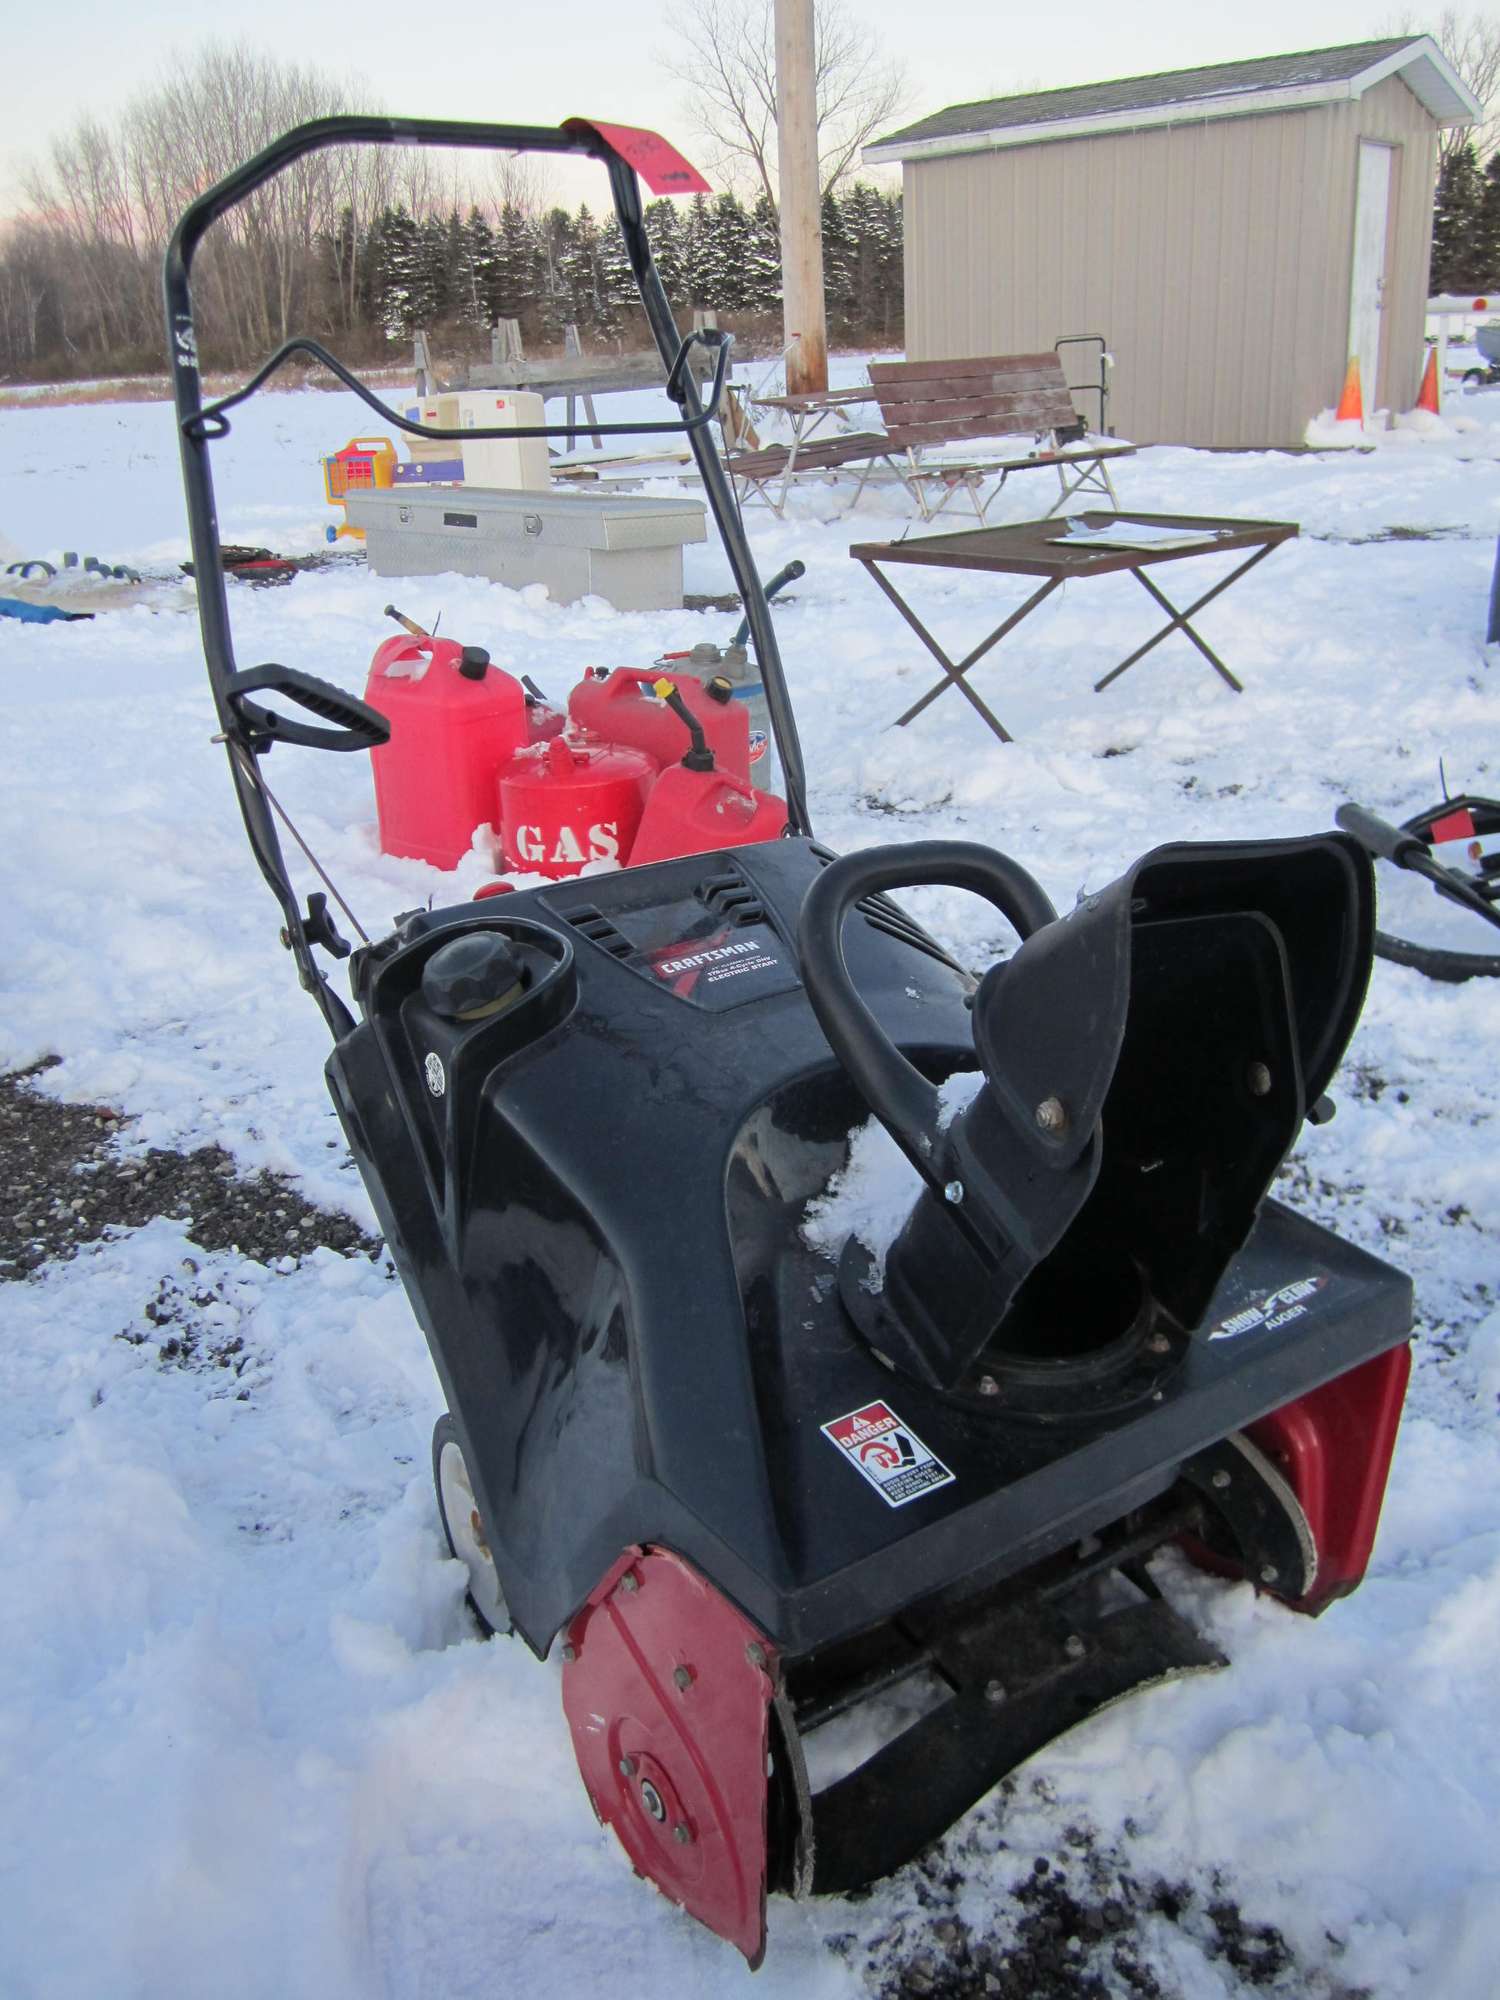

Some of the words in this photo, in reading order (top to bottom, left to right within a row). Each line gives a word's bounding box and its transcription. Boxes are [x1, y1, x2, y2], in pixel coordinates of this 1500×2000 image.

[517, 822, 619, 862] GAS
[661, 941, 760, 974] CRAFTSMAN
[708, 967, 750, 982] ELECTRIC
[751, 959, 778, 970] START
[1220, 1307, 1264, 1333] SNOW
[1278, 1281, 1317, 1304] CLAW
[1264, 1305, 1308, 1331] AUGER
[839, 1417, 897, 1448] DANGER
